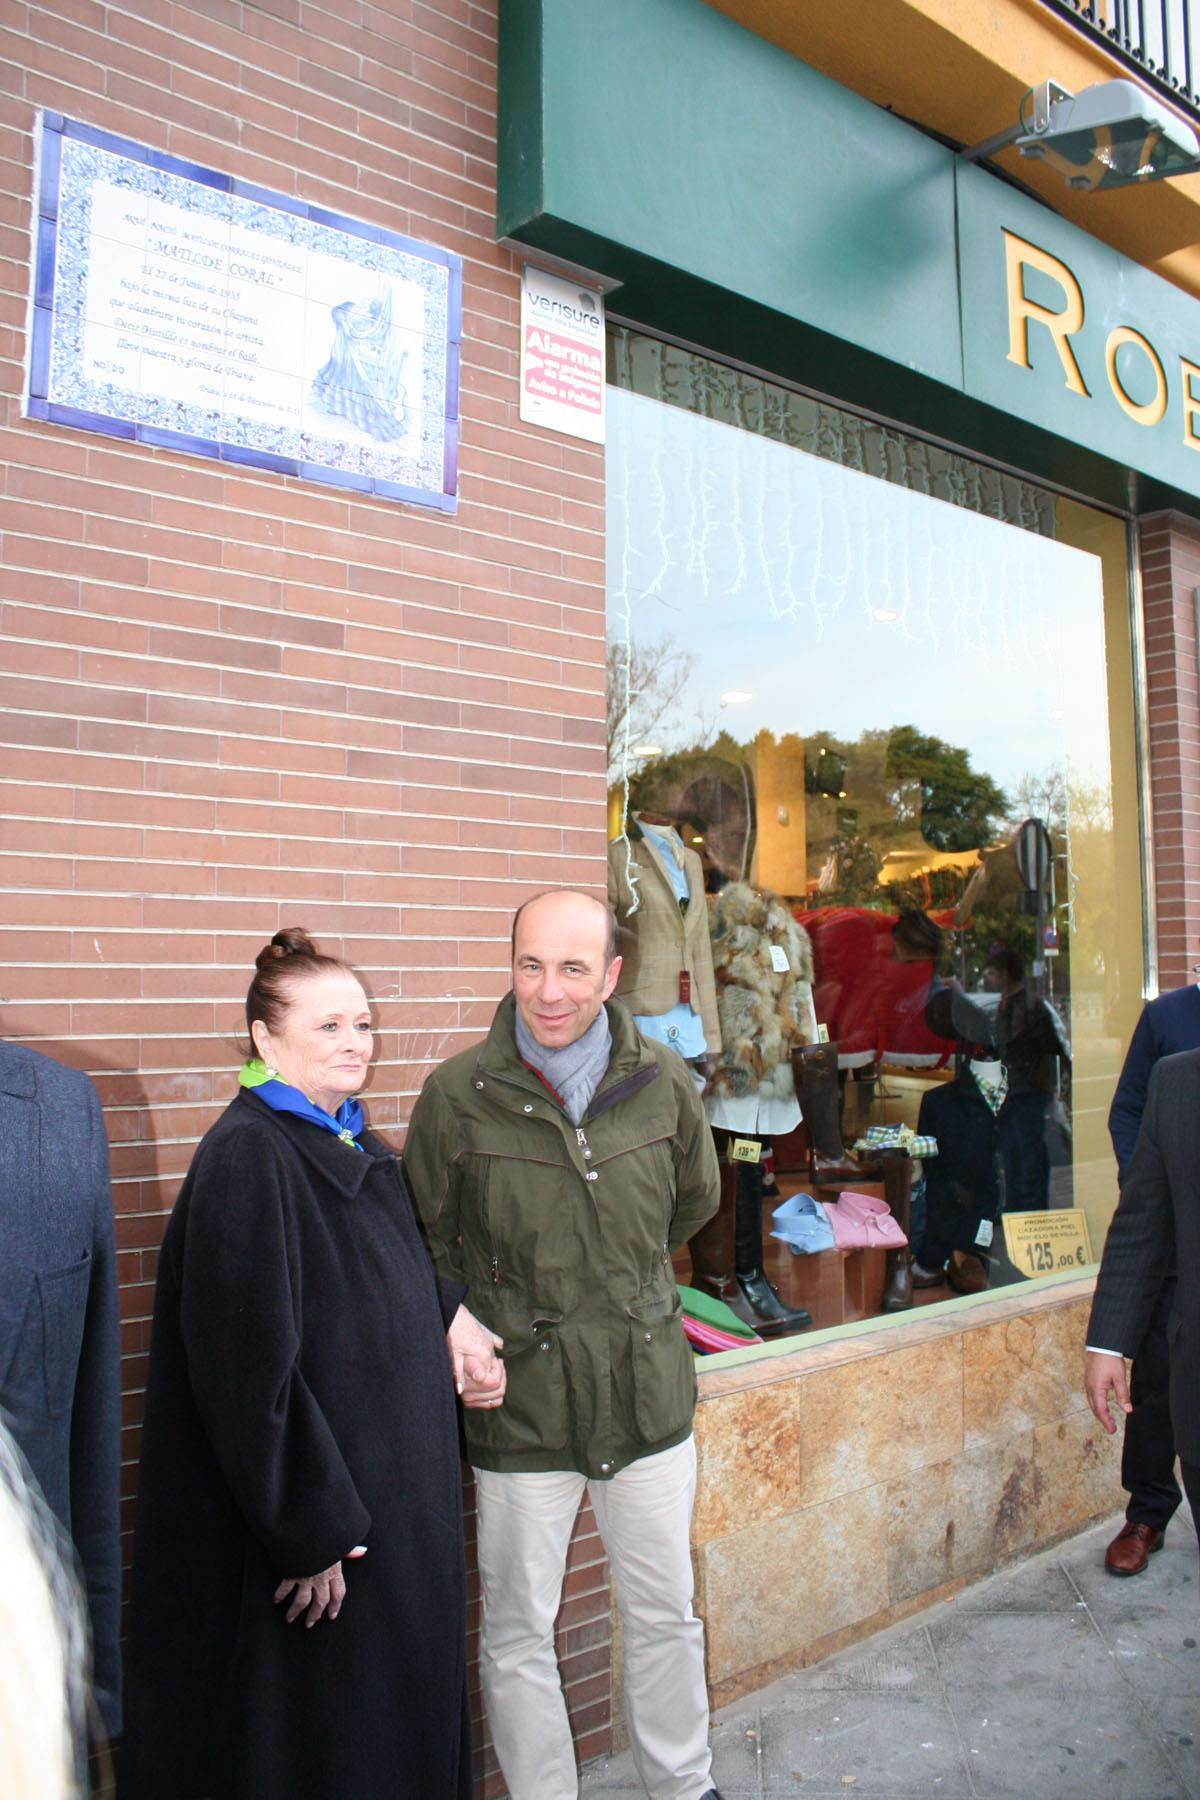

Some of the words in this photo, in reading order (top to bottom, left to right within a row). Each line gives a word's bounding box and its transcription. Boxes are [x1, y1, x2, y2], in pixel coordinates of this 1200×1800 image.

[156, 269, 167, 280] 22
[168, 271, 179, 283] de
[180, 277, 205, 291] Junio
[207, 283, 218, 295] de
[109, 297, 126, 309] que
[187, 319, 222, 335] corazón
[224, 327, 235, 338] de
[198, 300, 210, 312] de
[211, 306, 222, 316] su
[527, 291, 600, 330] verisure
[526, 330, 601, 372] Alarma
[178, 356, 185, 367] y
[185, 356, 211, 372] gloria
[212, 363, 224, 375] de
[528, 376, 558, 397] Aviso
[1076, 1245, 1085, 1265] €
